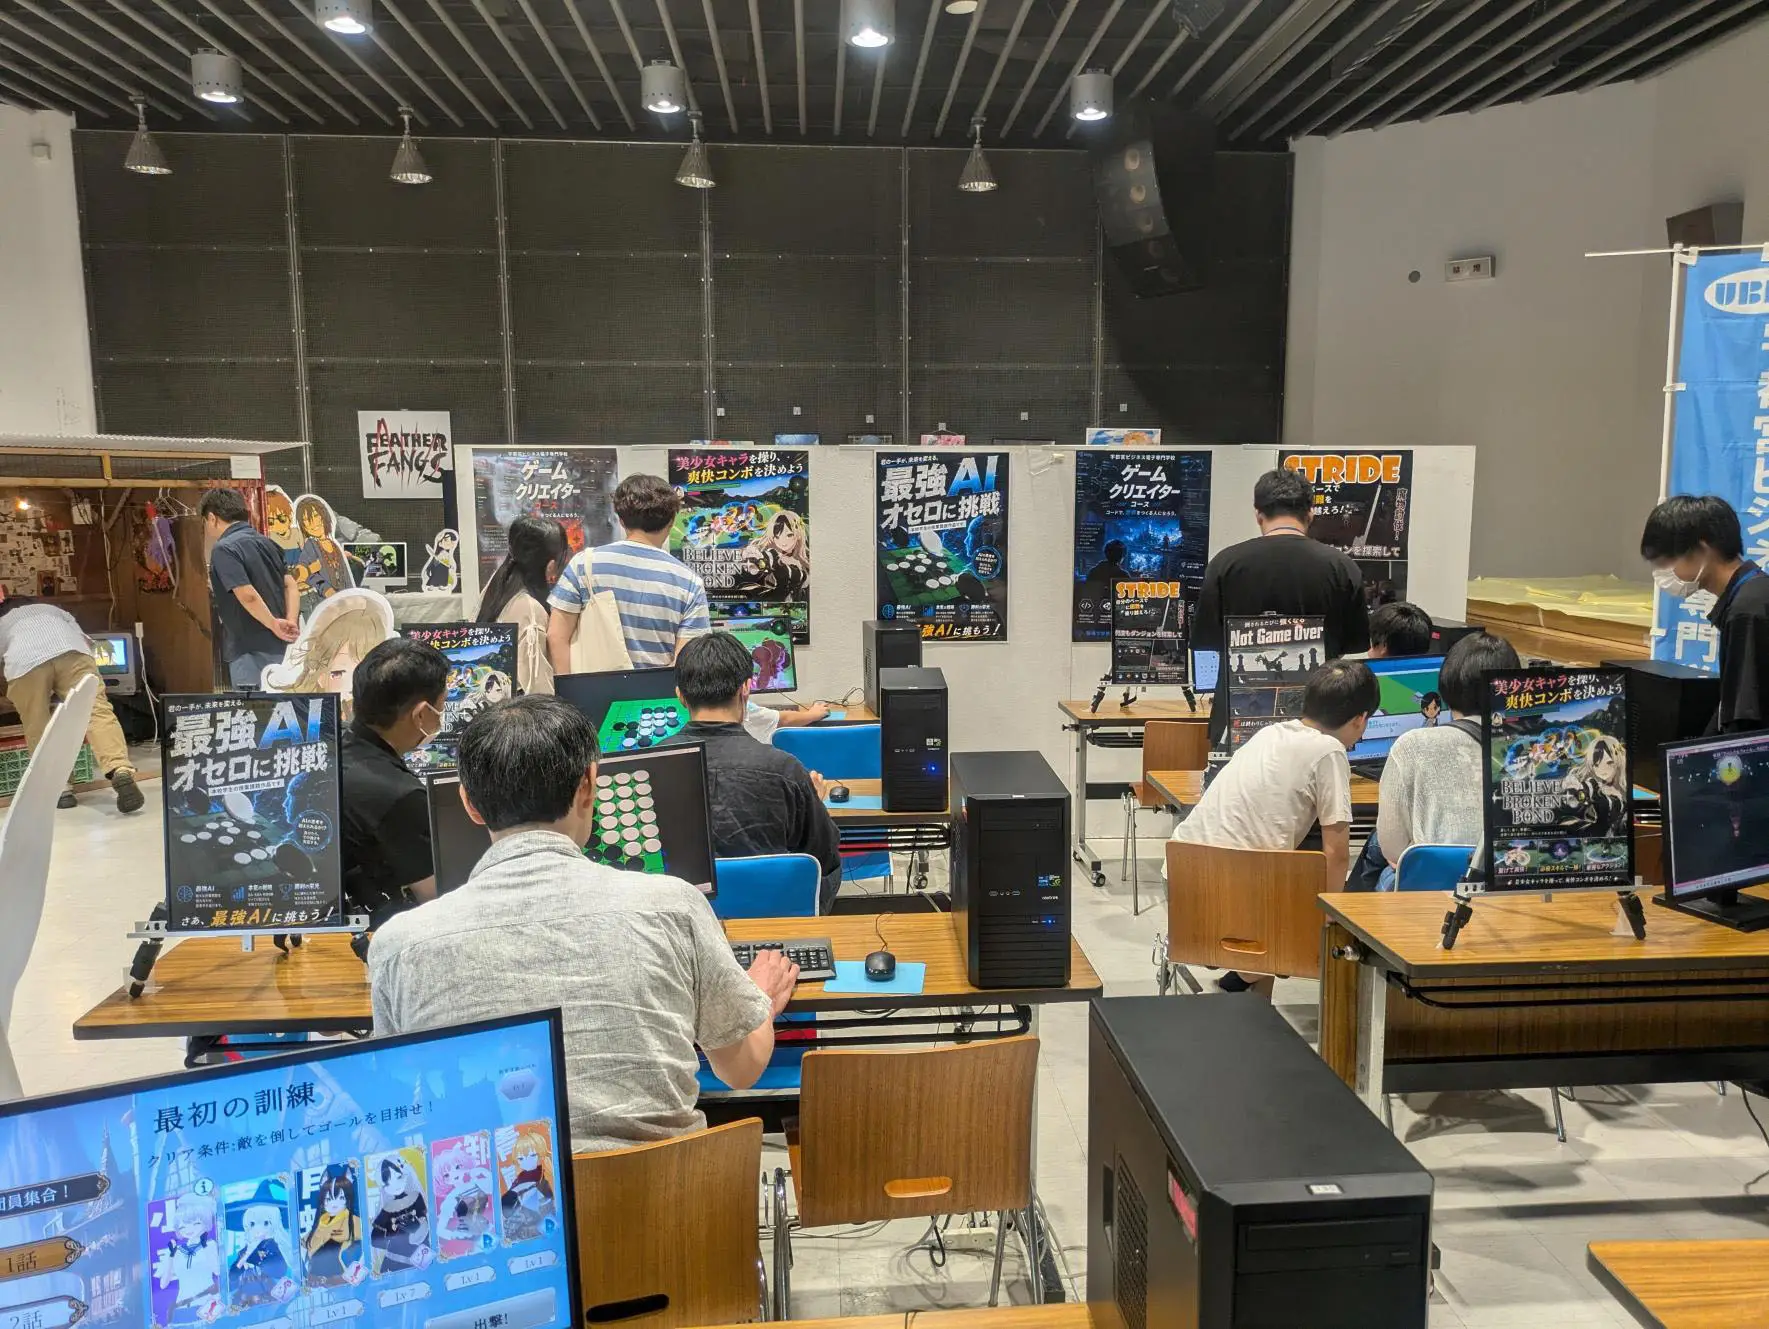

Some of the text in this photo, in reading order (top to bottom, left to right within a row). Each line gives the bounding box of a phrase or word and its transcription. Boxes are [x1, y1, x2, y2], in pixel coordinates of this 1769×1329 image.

[1715, 281, 1769, 305] UB
[366, 432, 448, 453] FEATHER
[368, 450, 448, 488] FANGS
[521, 460, 568, 480] ゲーム
[687, 463, 803, 484] 爽快コンボを決めよう
[1121, 464, 1167, 482] ゲーム
[1283, 454, 1402, 484] STRIDE
[881, 455, 999, 502] 最強AI
[515, 483, 581, 500] クリエイター
[1109, 483, 1181, 499] クリエイター
[1311, 485, 1340, 493] ースで
[881, 491, 1000, 529] オセロに挑戦
[682, 548, 742, 562] BELIEVE
[689, 562, 743, 576] ROKEN
[703, 575, 735, 588] OND
[1116, 582, 1180, 598] STRIDE
[915, 623, 1001, 637] 強AIに挑もう!
[1230, 625, 1324, 647] Not Game Over
[429, 635, 511, 650] 快コンボを決めよう
[1505, 683, 1623, 710] 爽快コンボを決めよう
[168, 700, 244, 712] 君の一手が、未来を変える。
[170, 698, 324, 758] 最強AI
[171, 741, 329, 792] オセロに挑戦
[1500, 779, 1560, 795] BELIEVE
[1503, 794, 1561, 809] BROKEN
[1512, 808, 1554, 824] BOND
[154, 1081, 315, 1135] 最初の訓練
